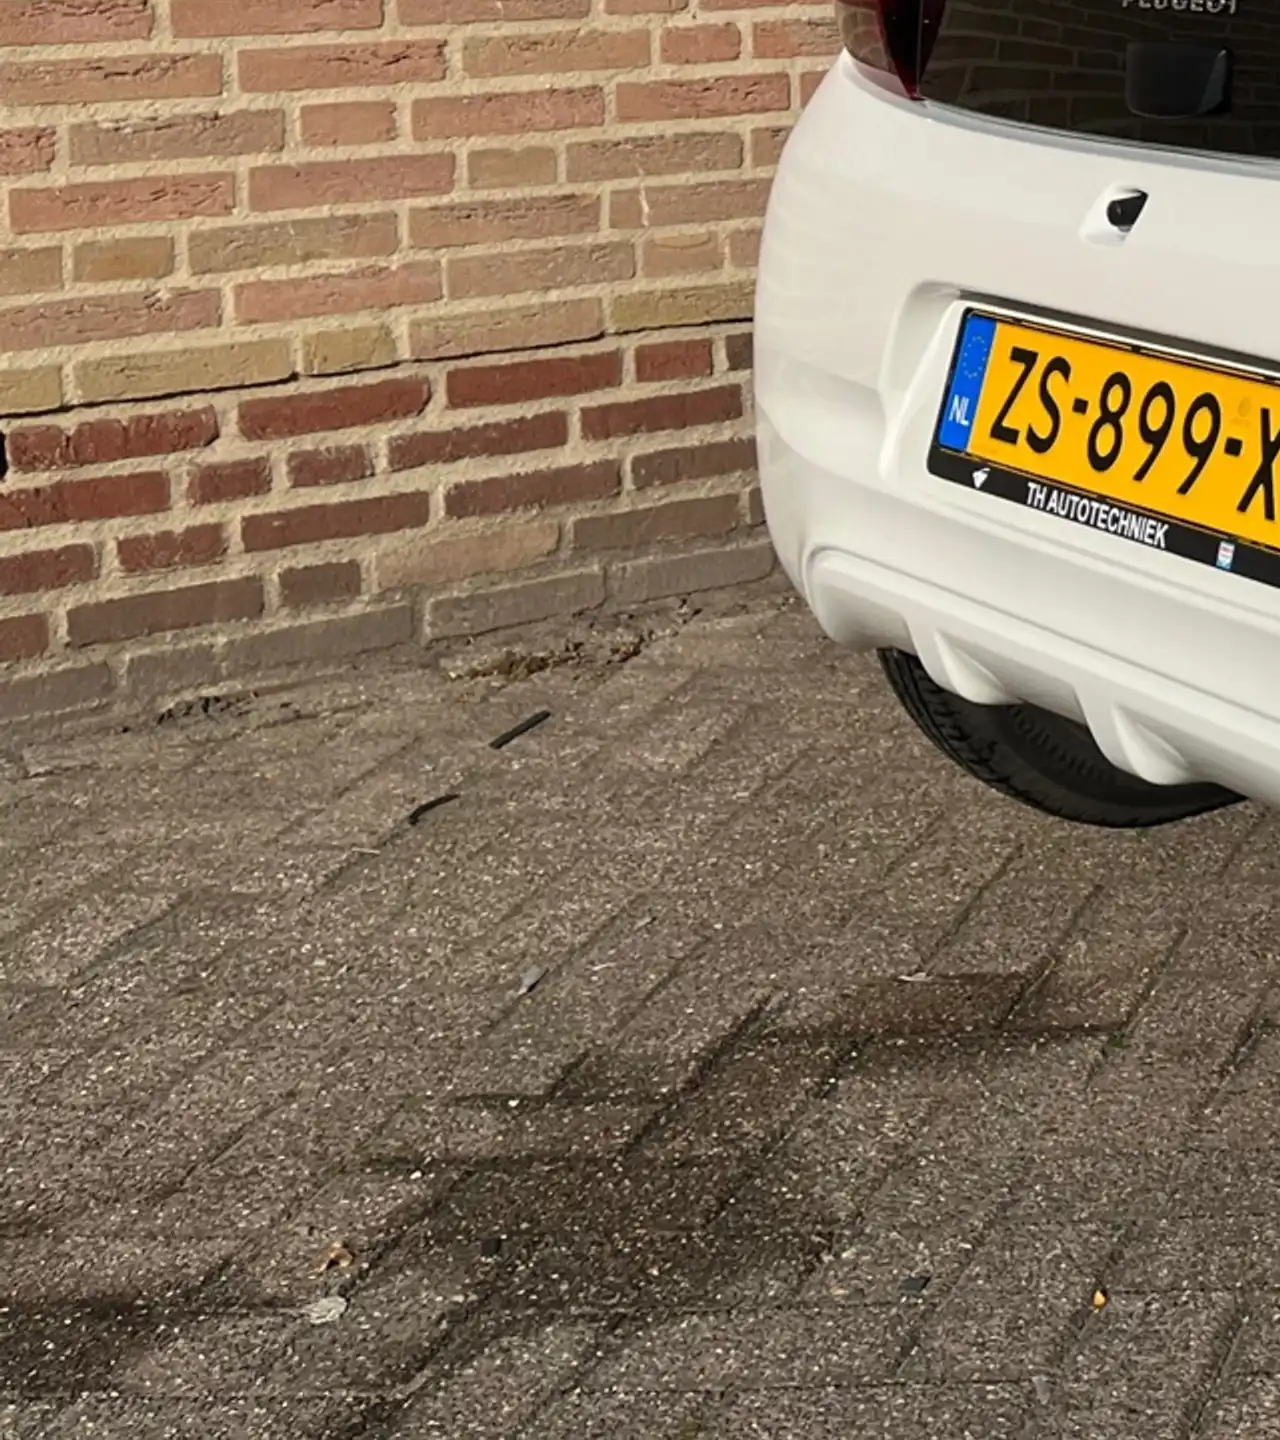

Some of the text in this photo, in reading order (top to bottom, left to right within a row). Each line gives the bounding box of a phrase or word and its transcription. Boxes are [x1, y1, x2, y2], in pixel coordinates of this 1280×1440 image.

[949, 394, 971, 427] NL
[1026, 482, 1169, 549] TH AUTOTECHNIEK
